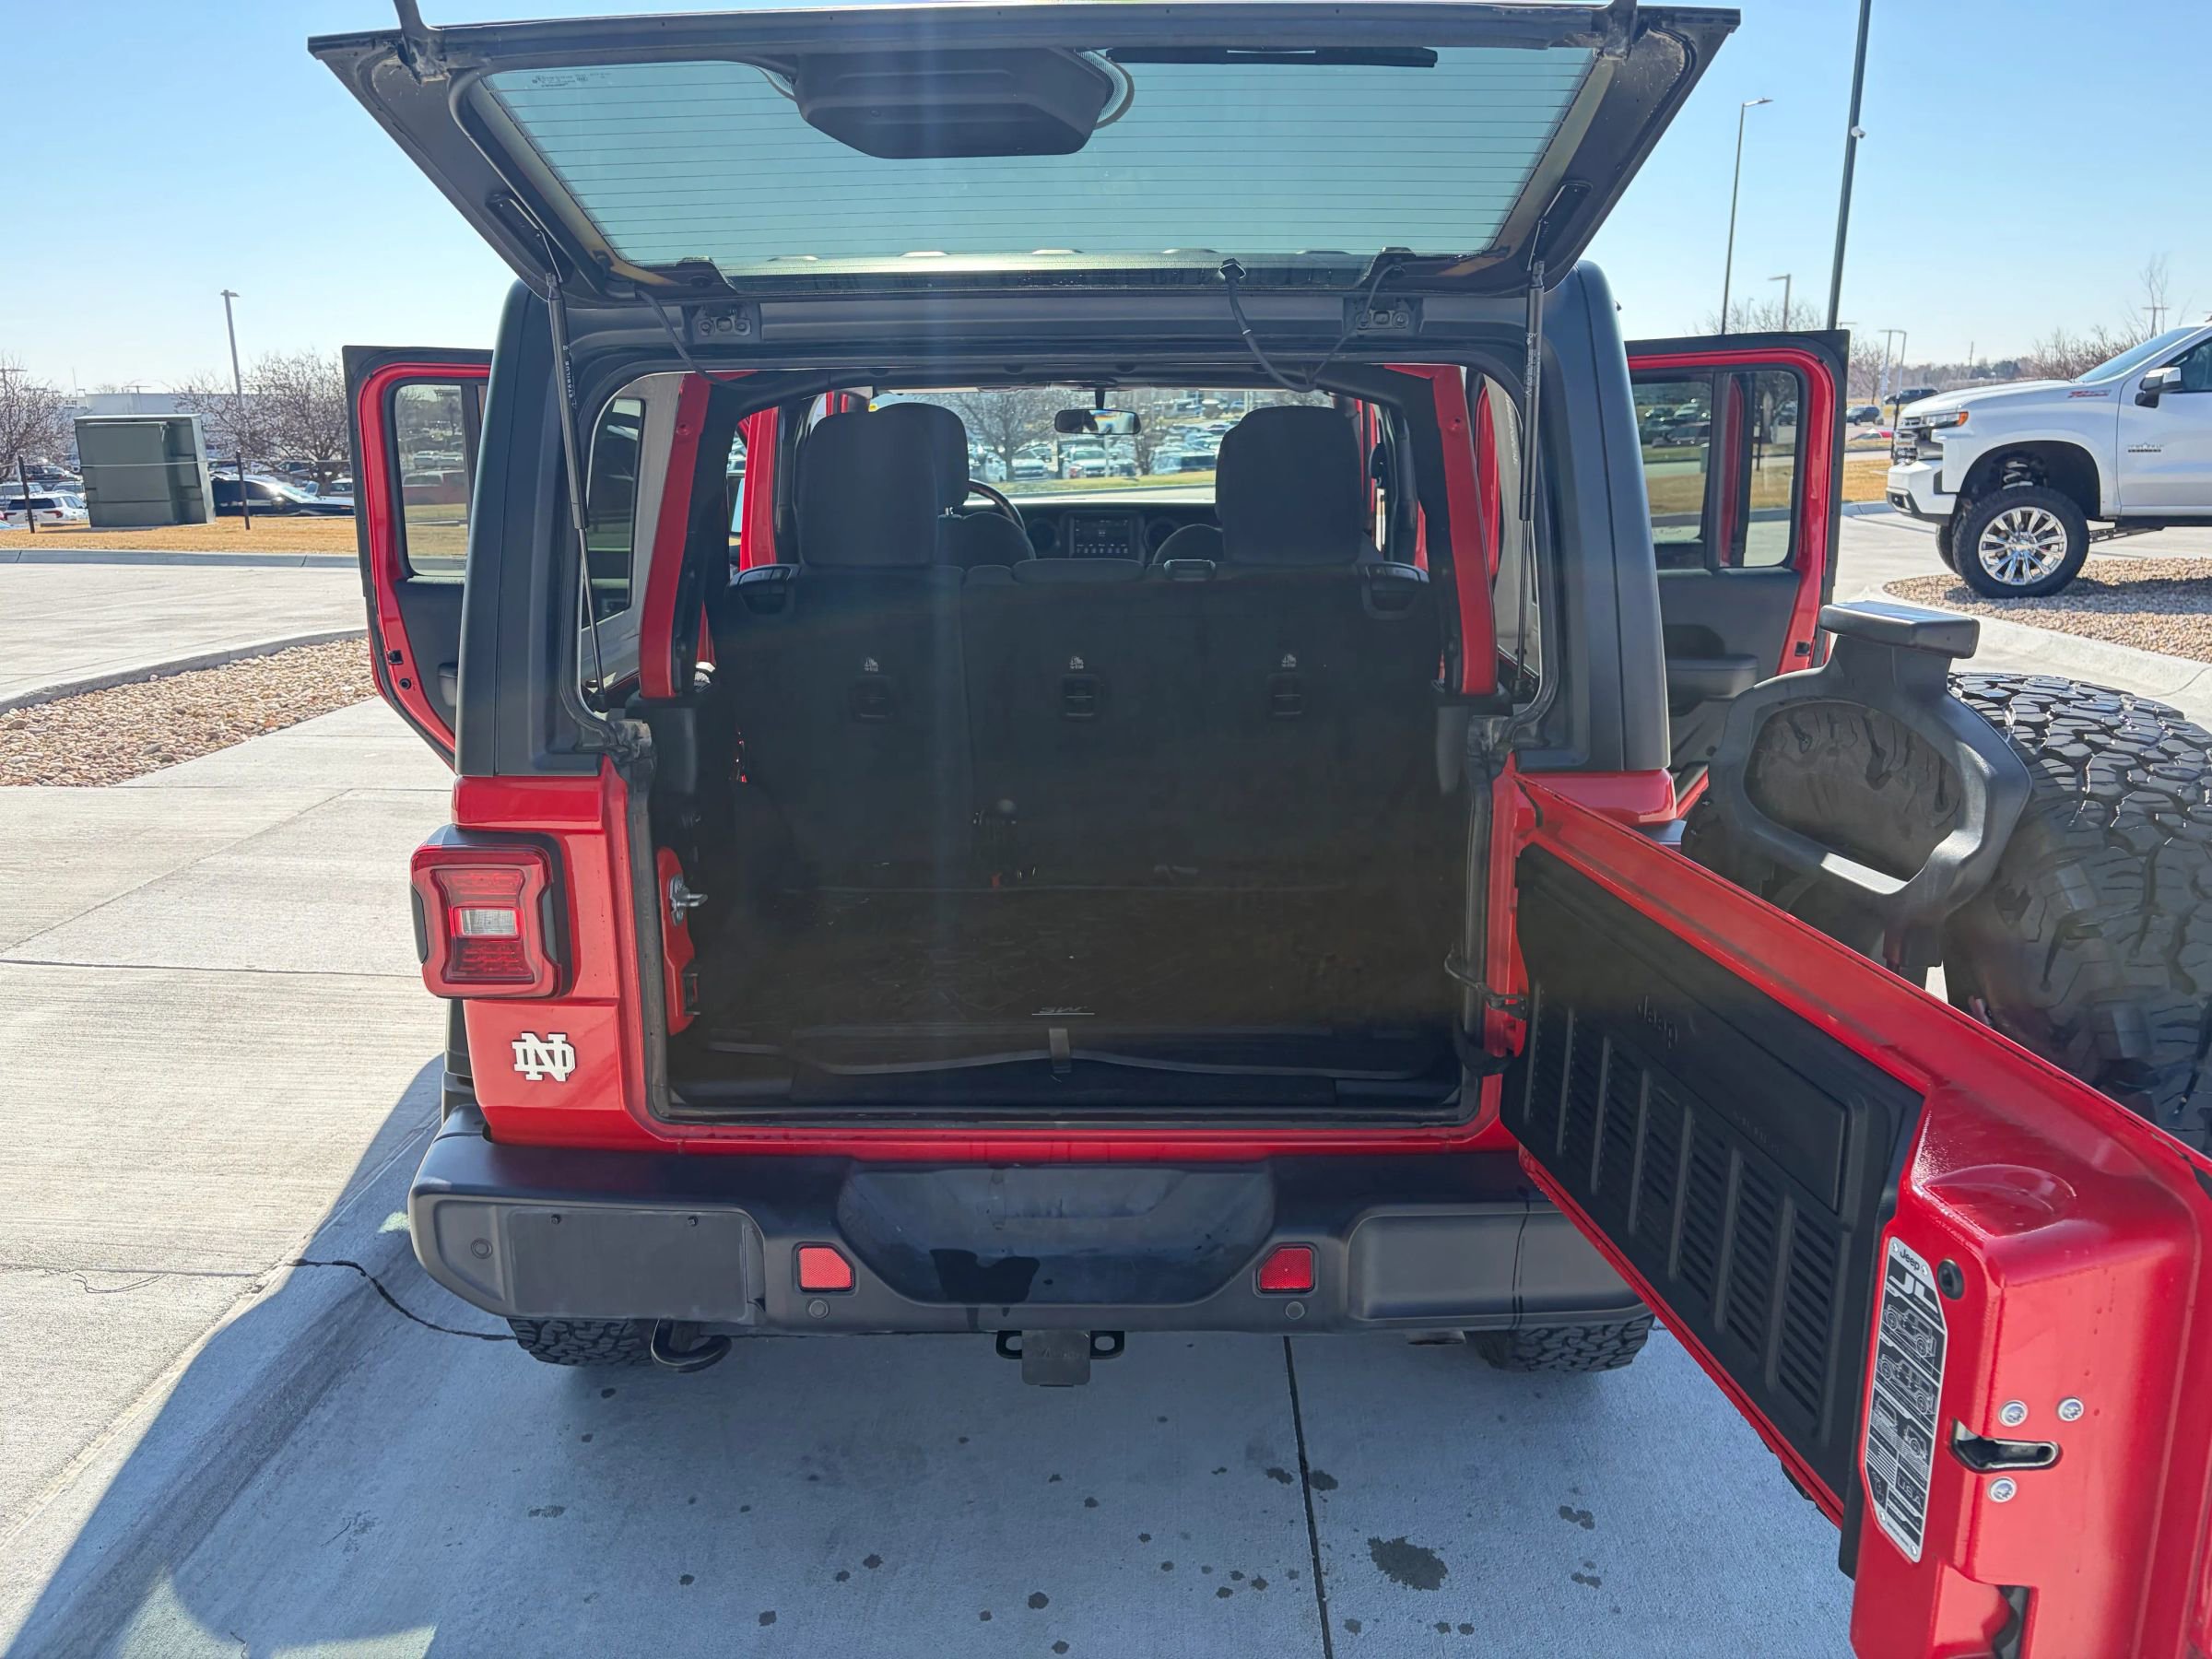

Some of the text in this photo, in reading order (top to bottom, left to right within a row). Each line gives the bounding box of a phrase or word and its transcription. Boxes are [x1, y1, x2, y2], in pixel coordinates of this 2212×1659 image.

[565, 360, 573, 398] STABILUS
[1900, 1249, 1920, 1271] Jeep
[1888, 1272, 1939, 1314] JL
[1897, 1475, 1924, 1511] USA
